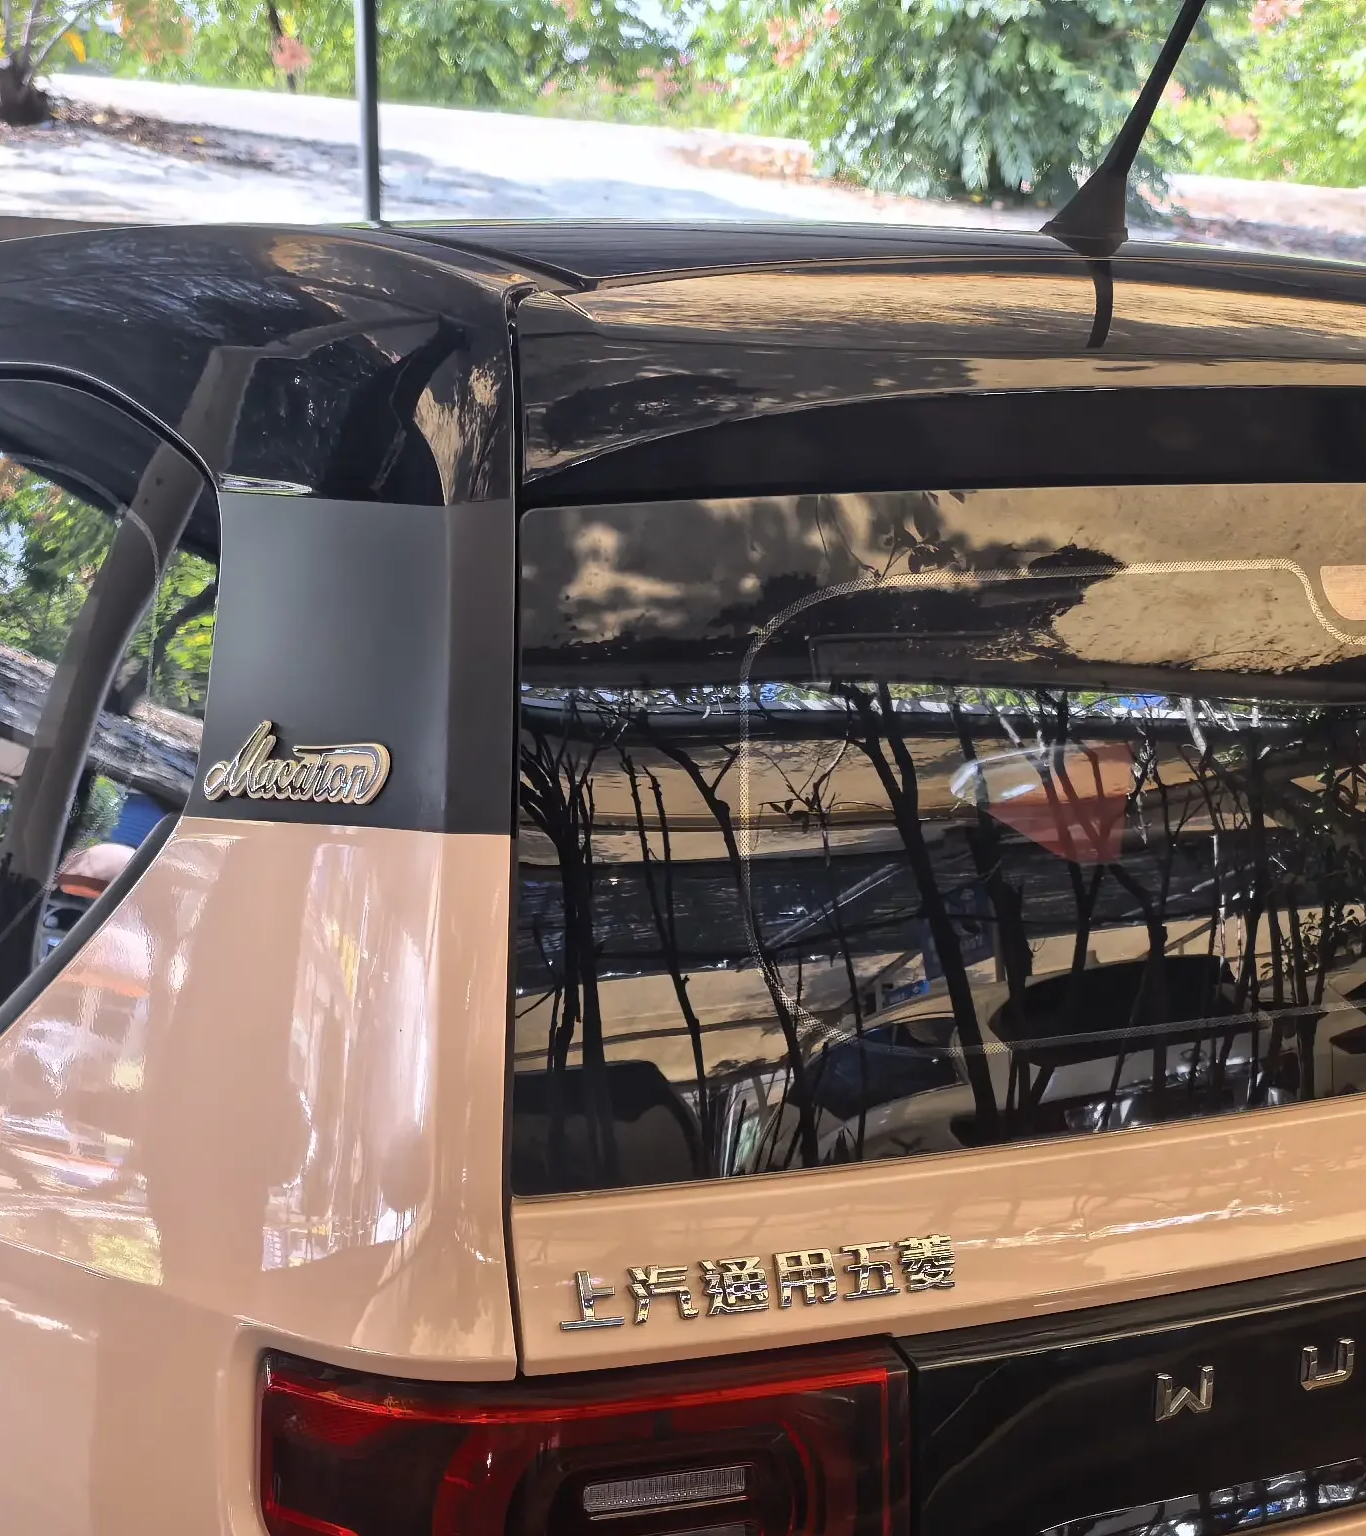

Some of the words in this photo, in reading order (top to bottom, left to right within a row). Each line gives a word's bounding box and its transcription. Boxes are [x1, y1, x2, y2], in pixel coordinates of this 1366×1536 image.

[203, 719, 391, 806] Macaron
[559, 1232, 956, 1331] 上汽通用五菱
